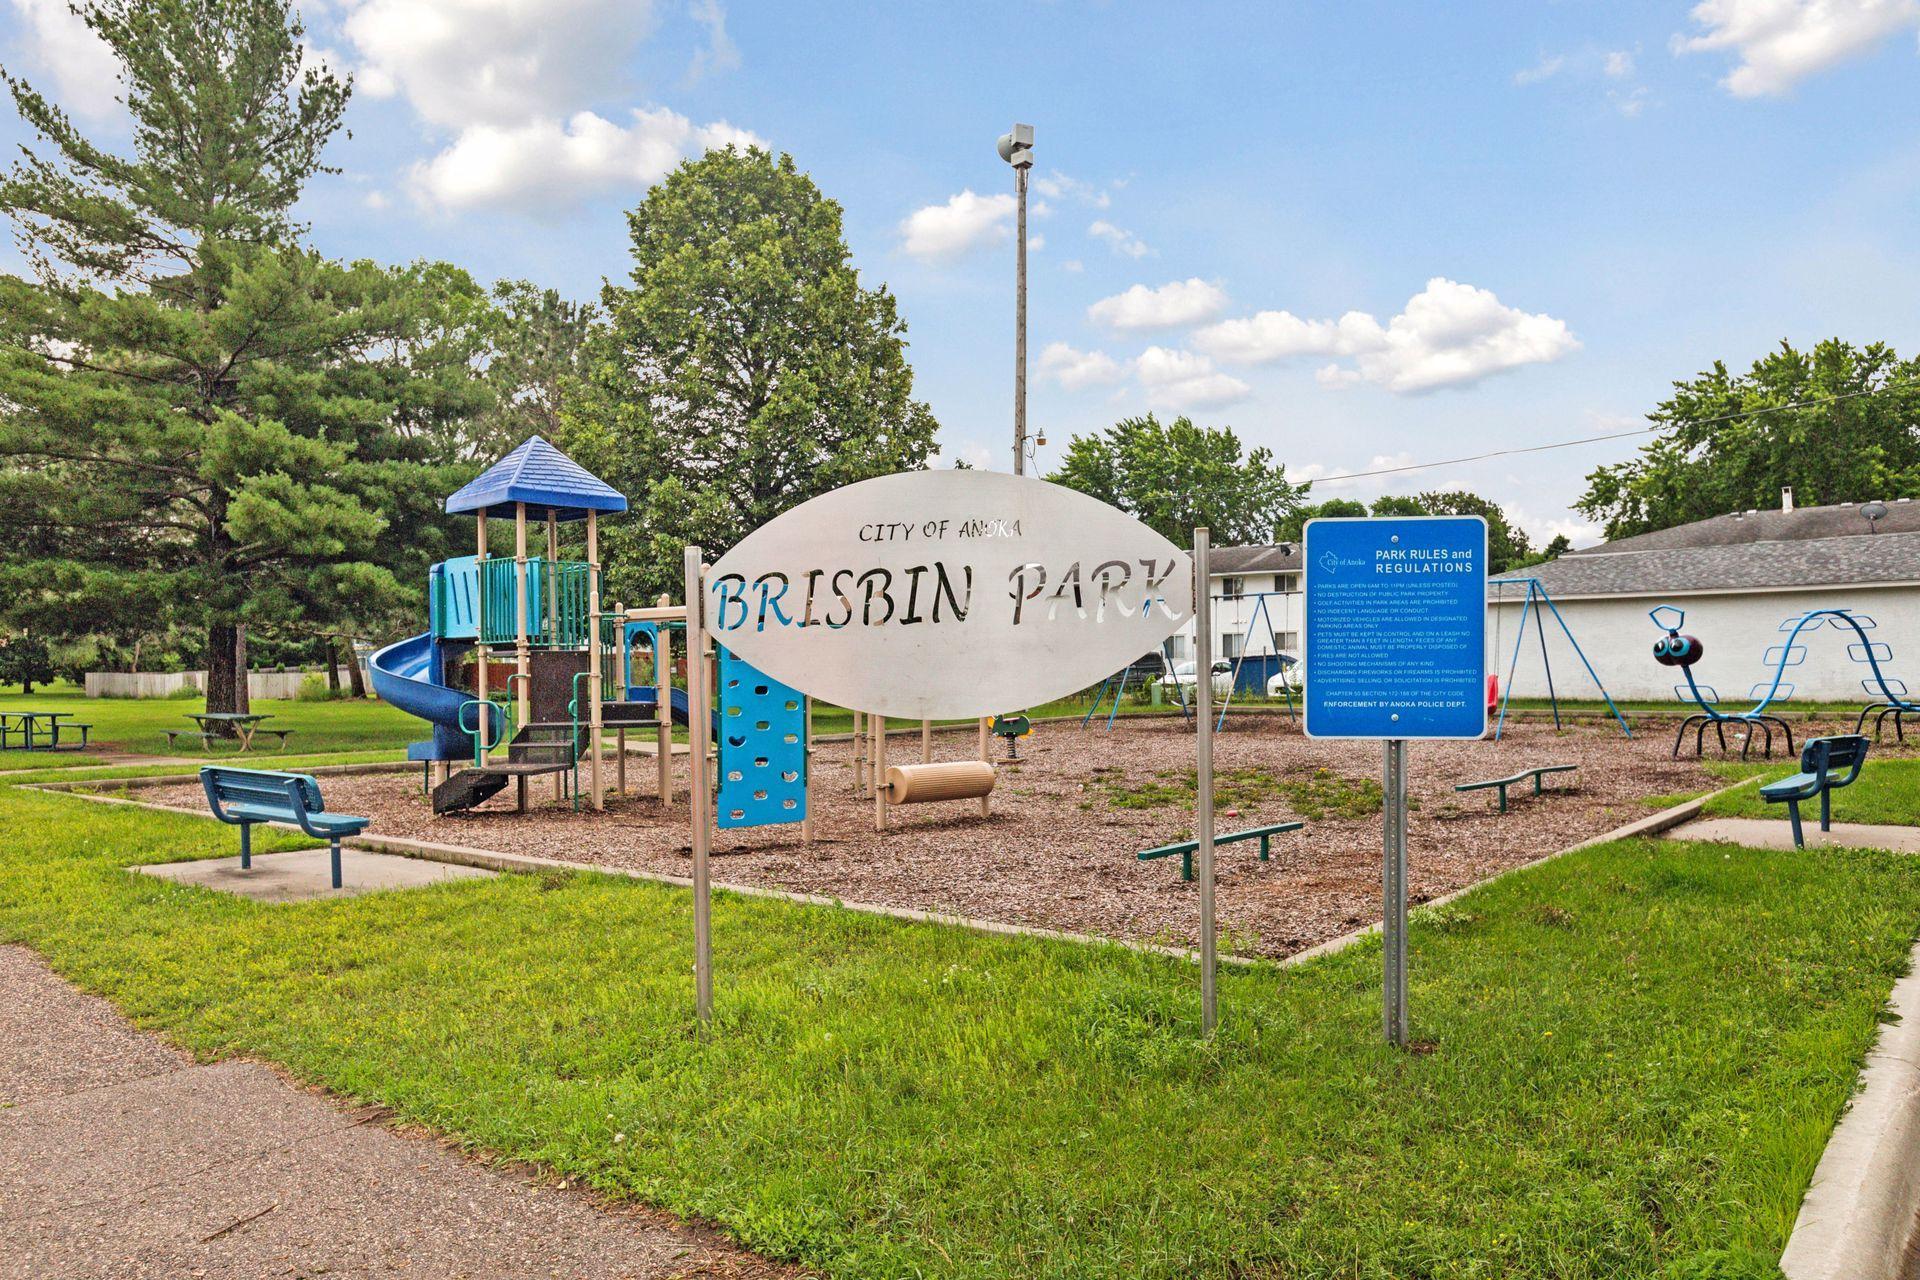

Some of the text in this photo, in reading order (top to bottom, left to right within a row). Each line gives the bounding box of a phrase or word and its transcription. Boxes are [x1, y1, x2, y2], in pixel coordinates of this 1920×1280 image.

[859, 518, 1022, 542] CITY OF ANOKA
[1375, 549, 1472, 560] PARK RULES and
[1327, 559, 1338, 567] City
[1375, 563, 1473, 573] REGULATIONS
[711, 558, 1183, 632] BRISBIN PARK
